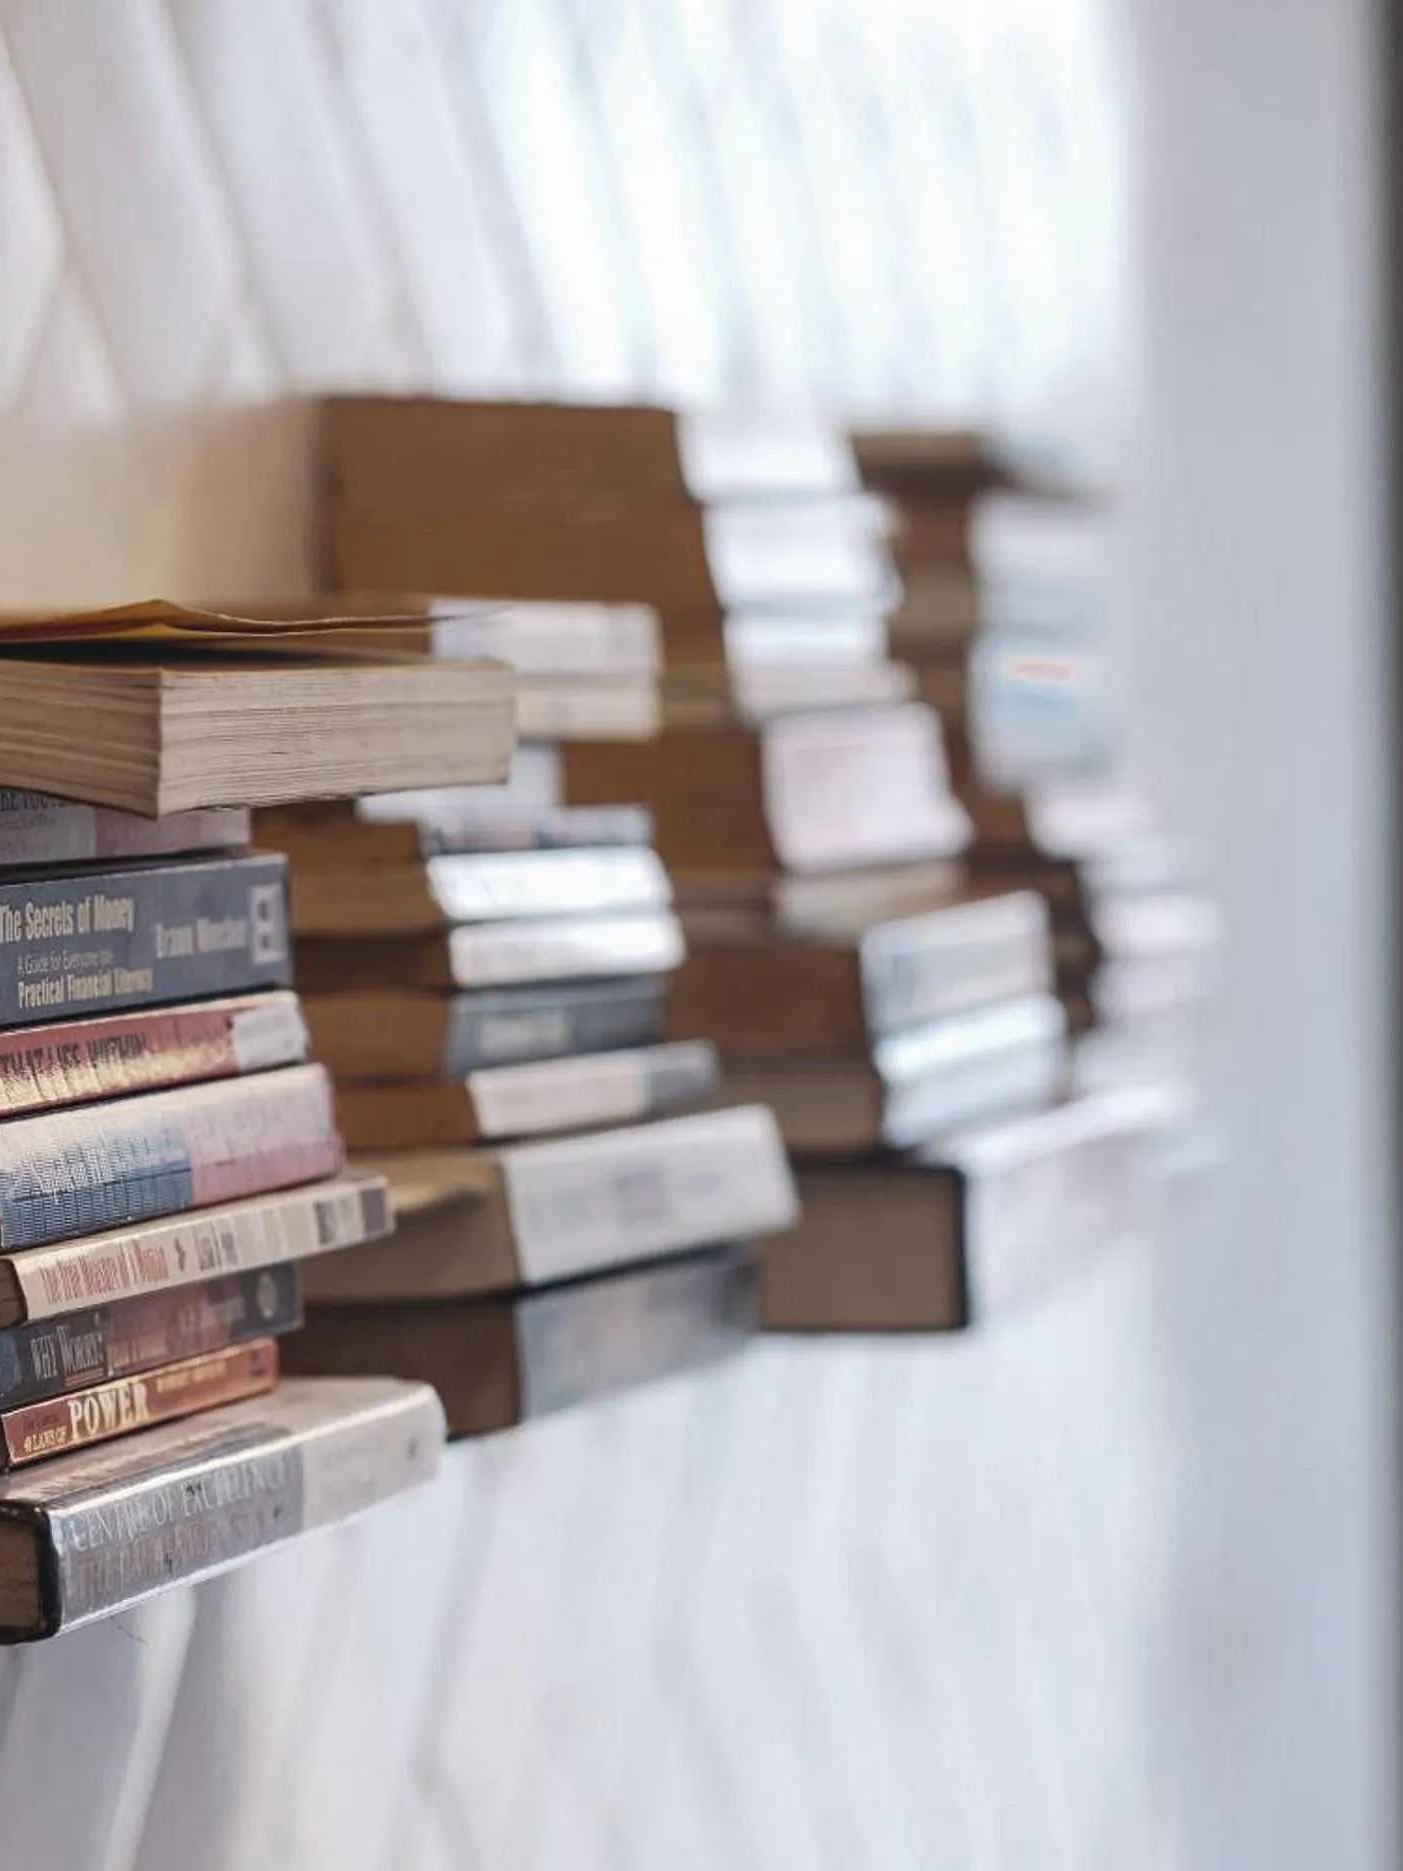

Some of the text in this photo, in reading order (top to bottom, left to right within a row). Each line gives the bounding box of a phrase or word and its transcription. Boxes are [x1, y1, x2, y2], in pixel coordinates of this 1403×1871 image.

[24, 901, 74, 940] Secrets
[77, 897, 91, 934] of
[24, 953, 49, 974] Guide
[49, 951, 62, 971] for
[18, 974, 65, 1008] Practical
[67, 968, 112, 1001] Financial
[30, 1333, 59, 1380] WHY
[67, 1379, 150, 1442] POWER
[152, 1489, 175, 1525] OF
